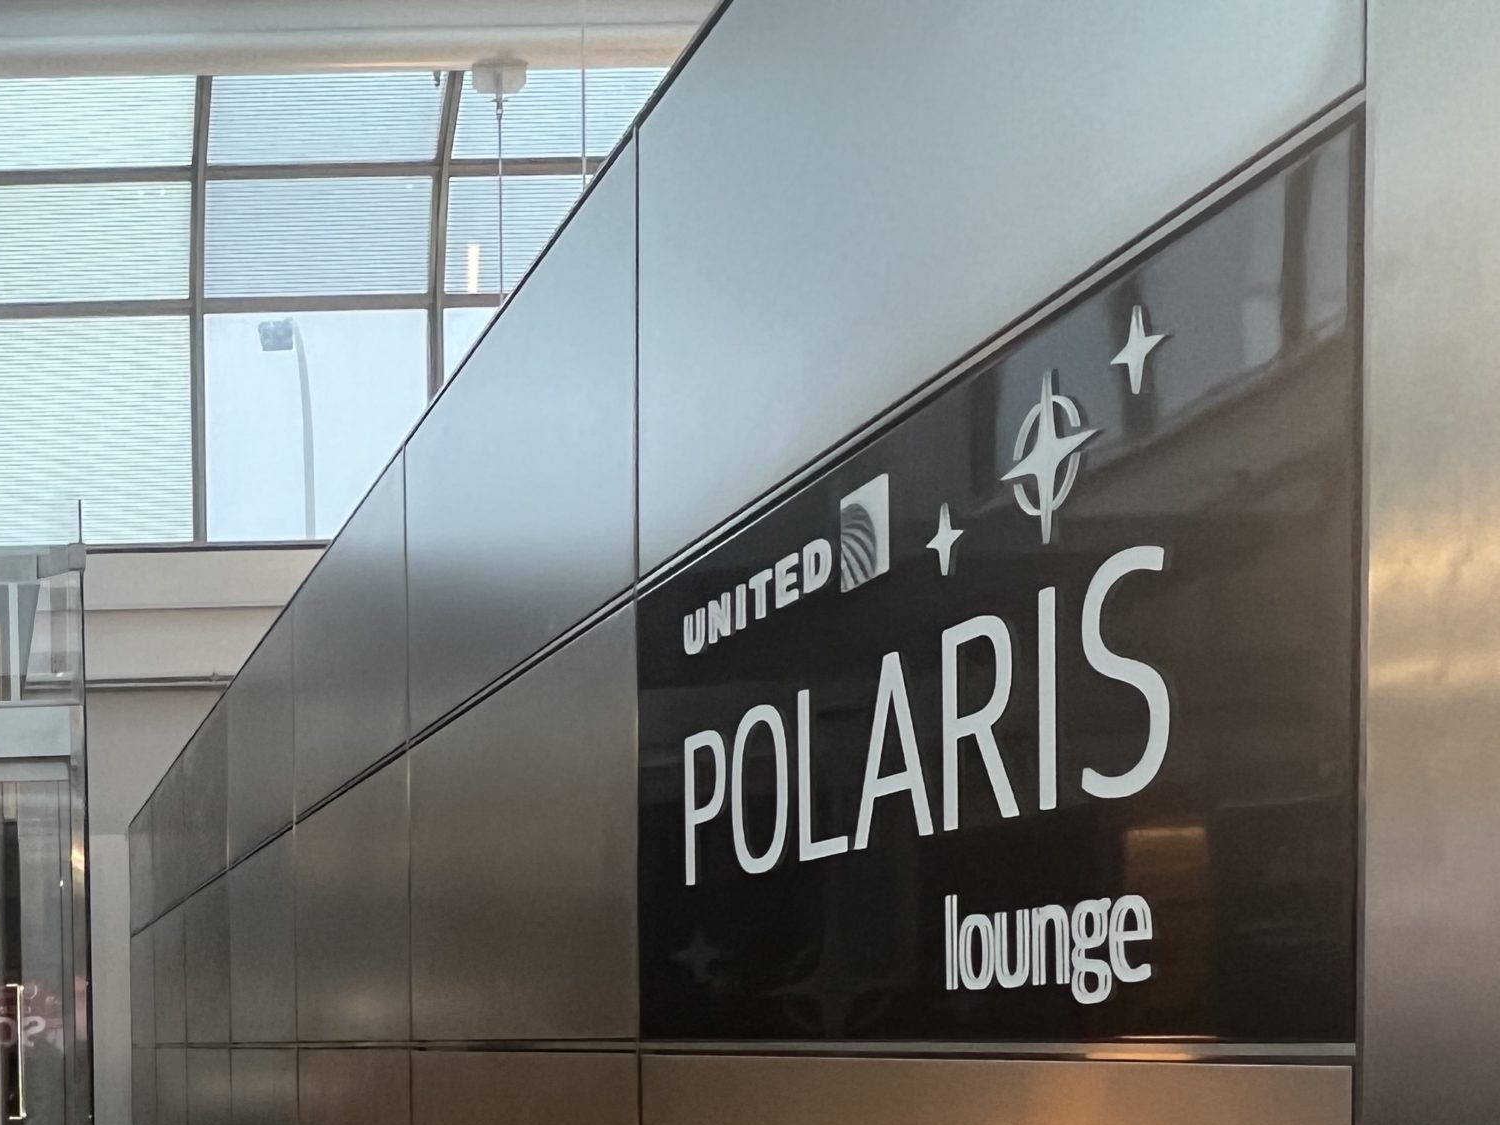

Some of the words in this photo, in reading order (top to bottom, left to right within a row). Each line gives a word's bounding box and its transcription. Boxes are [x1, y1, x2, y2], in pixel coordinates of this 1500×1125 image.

[683, 538, 833, 655] UNITED
[684, 545, 1170, 885] POLARIS
[945, 894, 1153, 1004] lounge
